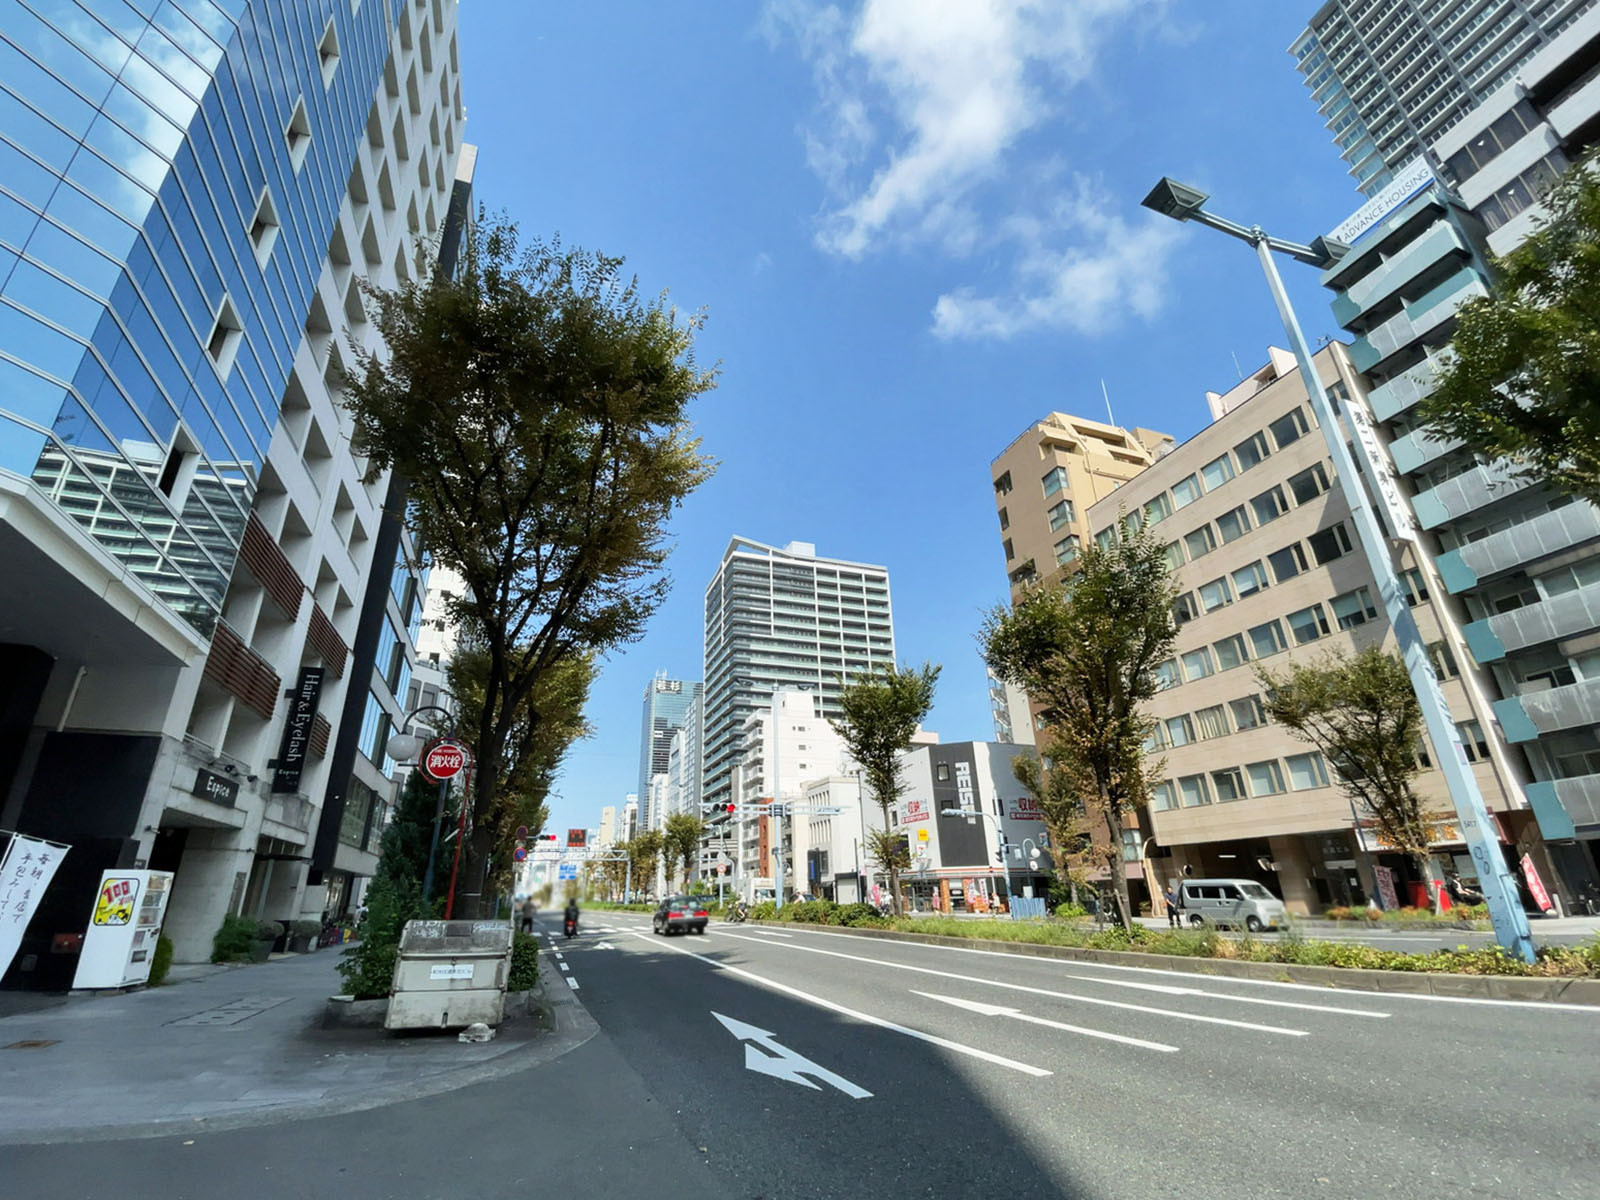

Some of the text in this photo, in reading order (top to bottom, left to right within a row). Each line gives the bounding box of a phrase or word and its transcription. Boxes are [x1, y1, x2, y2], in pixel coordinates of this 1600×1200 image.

[1343, 205, 1385, 242] ADVANCE
[1385, 168, 1429, 207] HOUSING
[301, 674, 320, 701] Hair
[286, 713, 311, 762] Eyelash
[430, 755, 461, 768] 消火栓
[103, 881, 131, 904] 100
